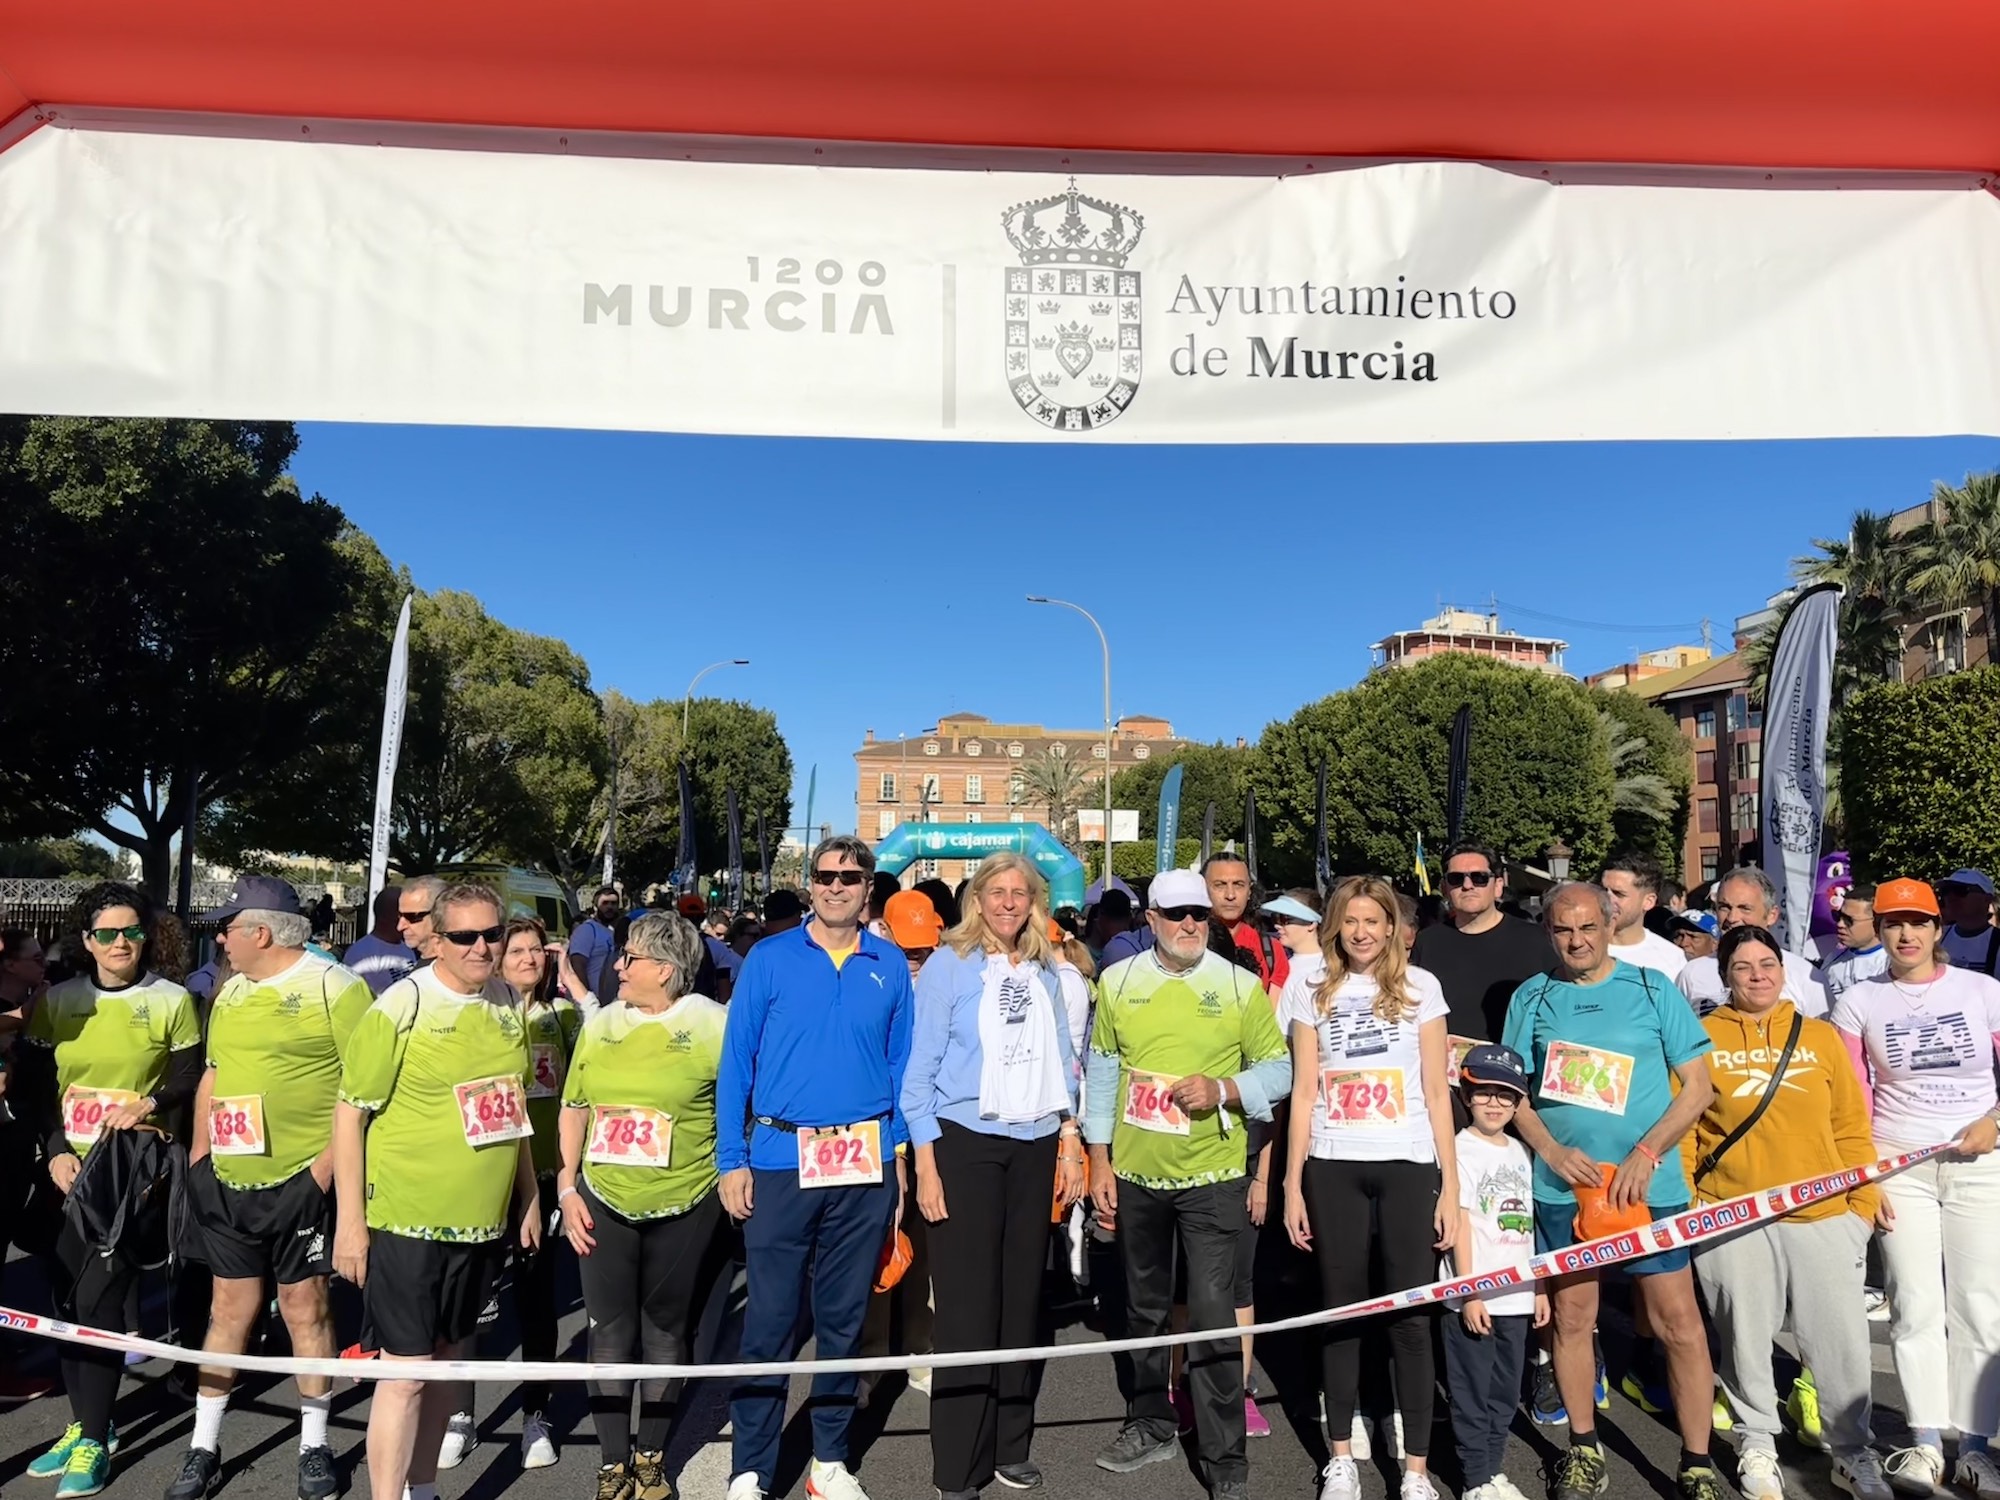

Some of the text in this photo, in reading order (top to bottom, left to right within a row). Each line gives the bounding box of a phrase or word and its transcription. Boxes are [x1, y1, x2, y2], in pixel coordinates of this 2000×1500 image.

[746, 256, 887, 287] 1200
[583, 282, 895, 335] MURCIA
[1165, 274, 1517, 327] Ayuntamiento
[1169, 333, 1439, 382] de Murcia
[1801, 708, 1812, 774] Murcia
[950, 832, 1013, 849] cajamar
[1711, 1045, 1818, 1070] Reebok
[1561, 1059, 1611, 1091] 496
[479, 1092, 516, 1121] 635
[1135, 1085, 1174, 1113] 760
[1340, 1083, 1388, 1109] 739
[215, 1112, 246, 1136] 638
[608, 1118, 653, 1146] 783
[817, 1138, 863, 1165] 692
[1799, 1167, 1859, 1200] FAMU
[1687, 1202, 1748, 1236] FAMU
[1565, 1239, 1633, 1269] FAMU
